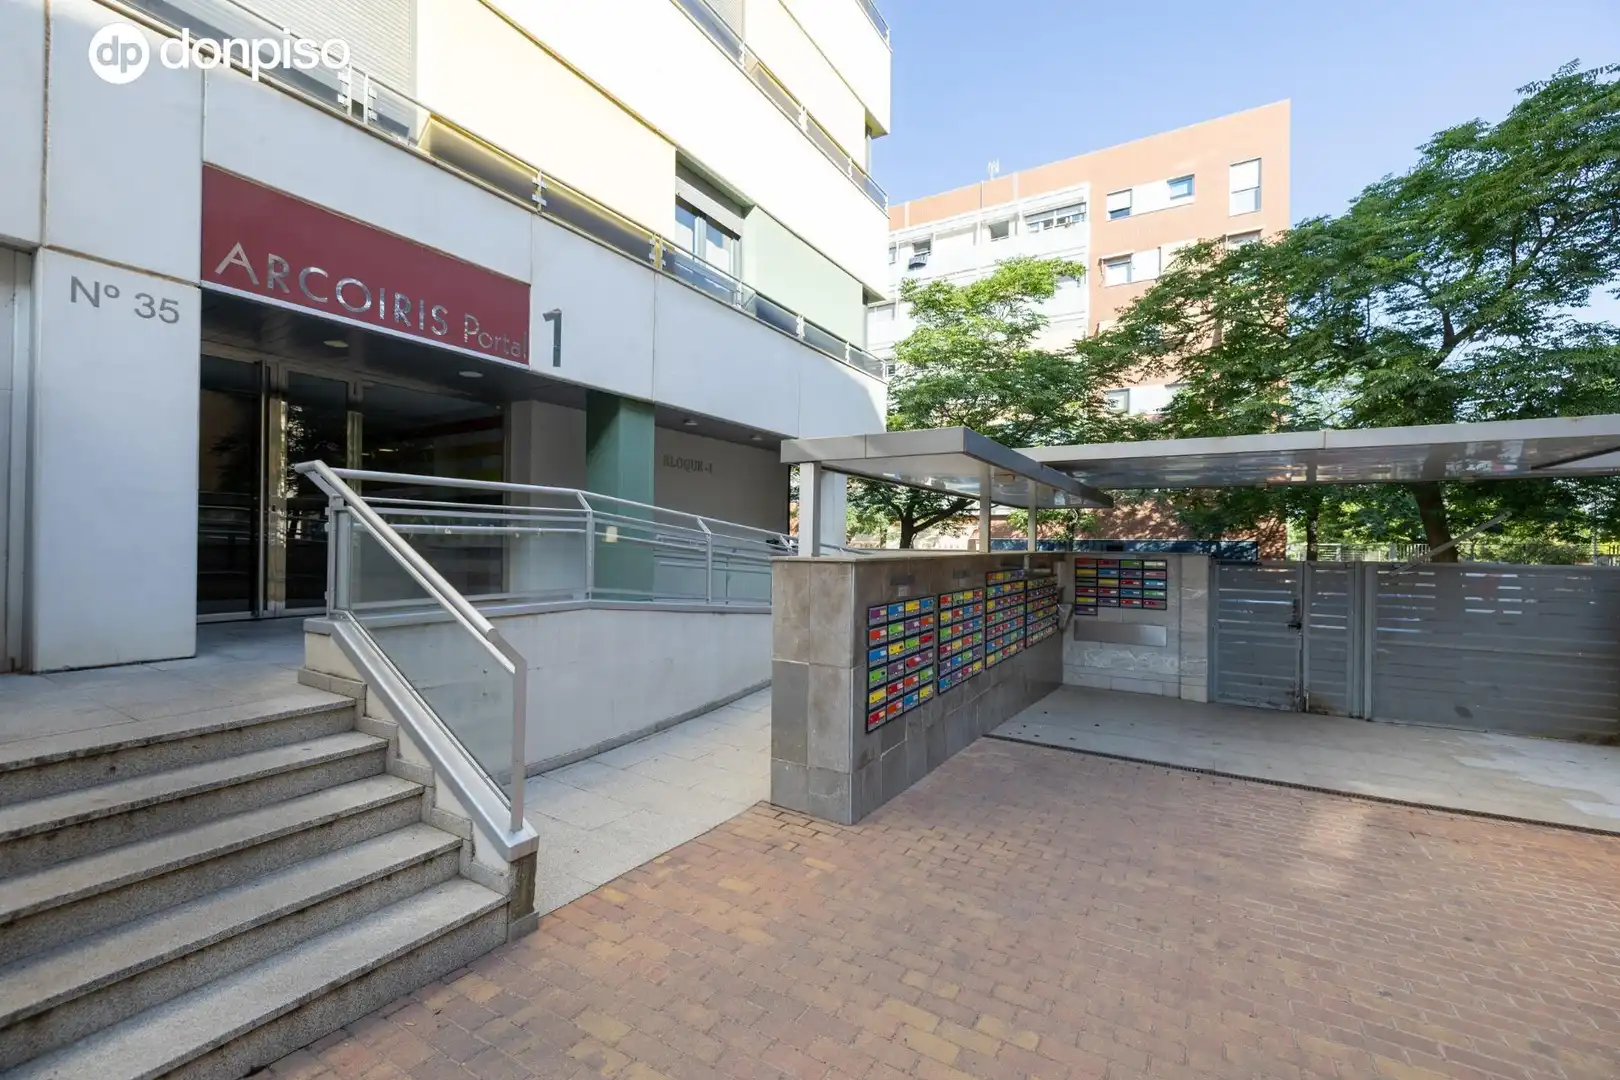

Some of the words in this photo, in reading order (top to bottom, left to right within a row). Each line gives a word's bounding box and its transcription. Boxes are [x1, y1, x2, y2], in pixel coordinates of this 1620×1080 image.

[133, 292, 180, 324] 35
[214, 241, 449, 336] ARCOIRIS
[464, 312, 527, 359] Portal
[542, 308, 562, 367] 1
